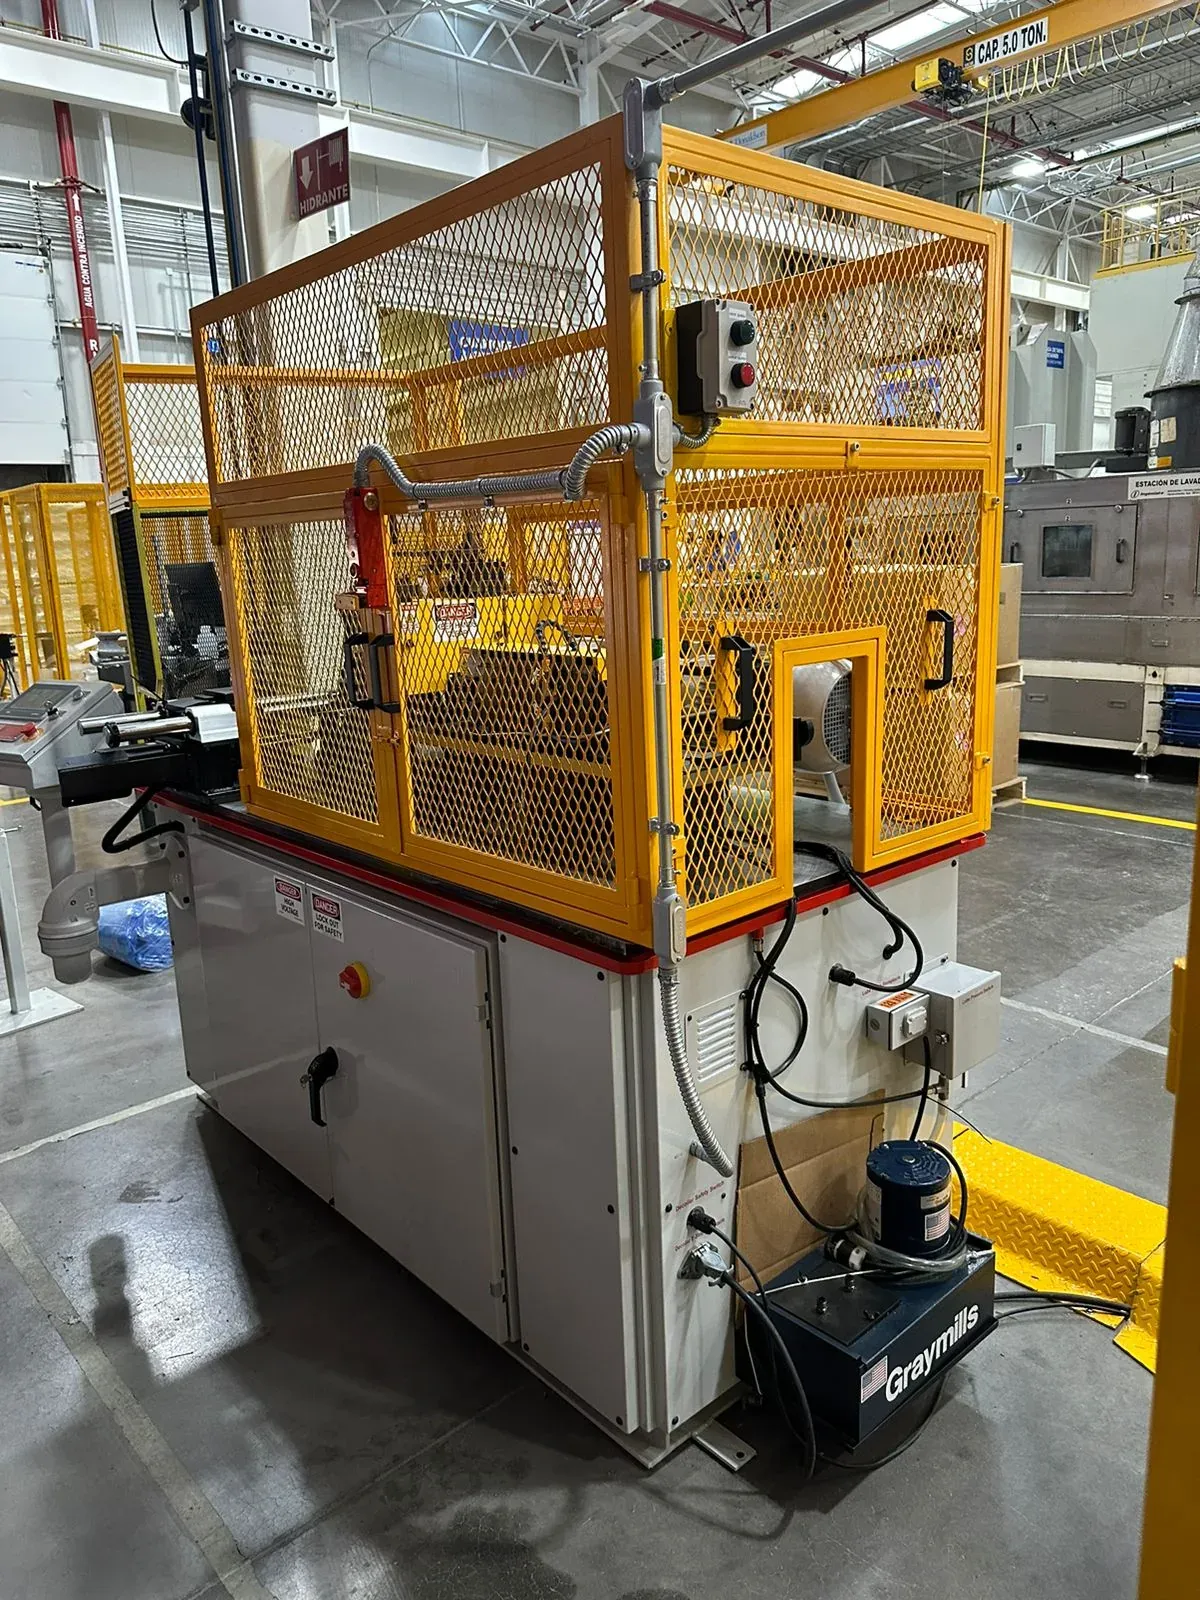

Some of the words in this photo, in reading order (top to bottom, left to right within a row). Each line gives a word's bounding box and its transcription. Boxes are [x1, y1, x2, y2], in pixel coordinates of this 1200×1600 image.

[978, 38, 999, 64] CAP.
[1002, 31, 1018, 56] 5.0
[1021, 21, 1046, 48] TON.
[300, 183, 348, 216] HIDRANTE
[74, 215, 87, 254] INCENDIO
[79, 253, 91, 285] CONTRA
[85, 287, 94, 308] AGUA
[1135, 478, 1168, 488] ESTACIÓN
[1169, 478, 1179, 486] DE
[315, 898, 337, 914] DANGER
[314, 921, 324, 931] FOR
[324, 925, 343, 939] SAFETY
[315, 912, 329, 923] LOCK
[329, 918, 339, 929] OUT
[885, 1304, 979, 1403] Graymills
